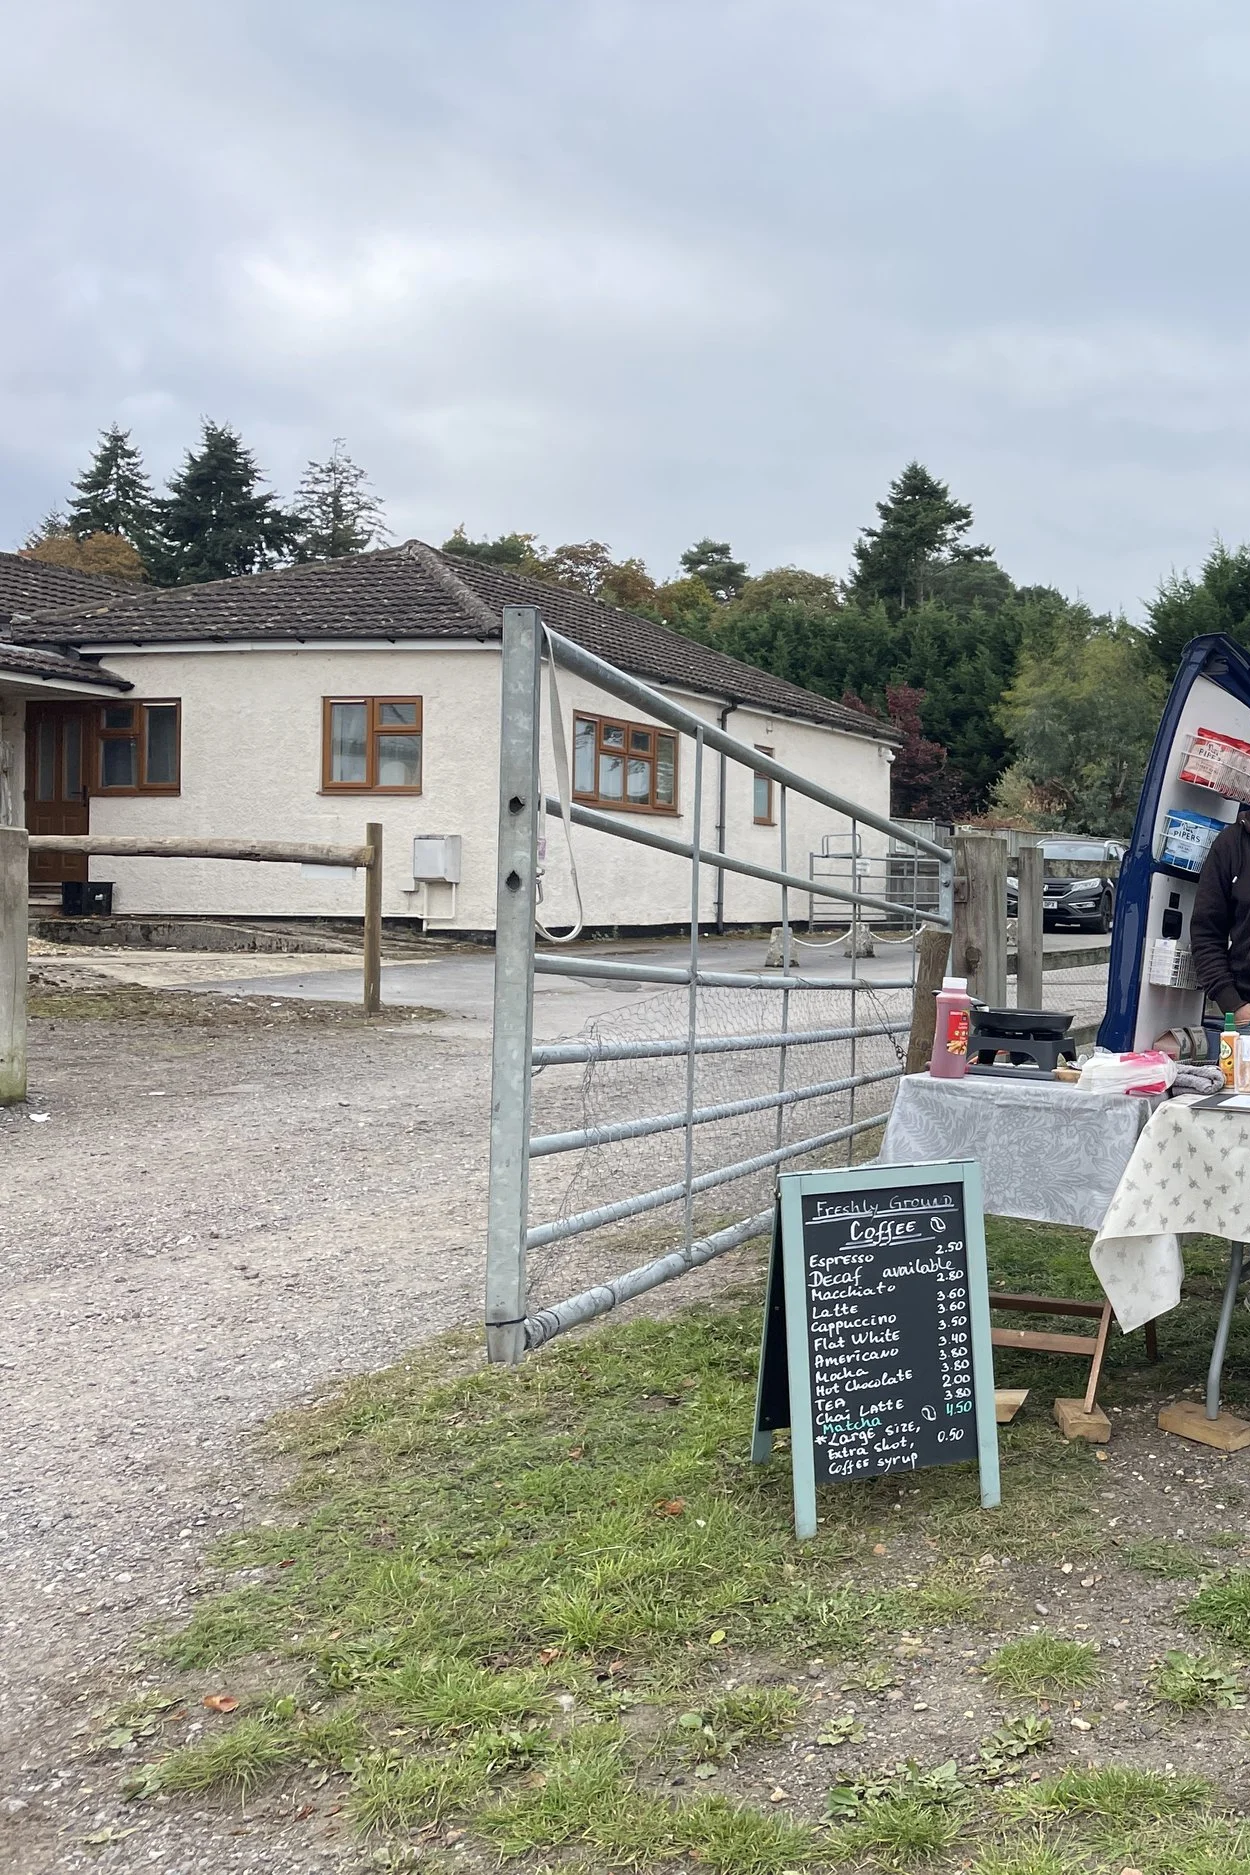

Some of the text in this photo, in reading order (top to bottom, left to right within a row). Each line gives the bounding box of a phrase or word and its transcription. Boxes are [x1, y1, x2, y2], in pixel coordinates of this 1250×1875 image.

[1173, 830, 1201, 843] PIPERS
[935, 1241, 963, 1254] 2.50
[882, 1257, 956, 1278] available
[811, 1270, 964, 1301] Macchiato 2.80
[936, 1288, 966, 1301] 3.60
[811, 1301, 966, 1337] Cappuccino 3.60
[814, 1337, 846, 1351] Flat
[938, 1316, 967, 1330] 3.50
[938, 1332, 967, 1346] 3.40
[815, 1347, 968, 1383] Mocha 3.80
[816, 1383, 840, 1397] Hot
[941, 1359, 970, 1372] 3.80
[942, 1374, 971, 1388] 2.00
[816, 1410, 850, 1426] Chai
[944, 1387, 972, 1400] 3.80
[823, 1401, 972, 1435] Matcha 4.50
[828, 1445, 868, 1460] Extra
[937, 1428, 964, 1443] 0.50
[877, 1452, 918, 1472] syrup
